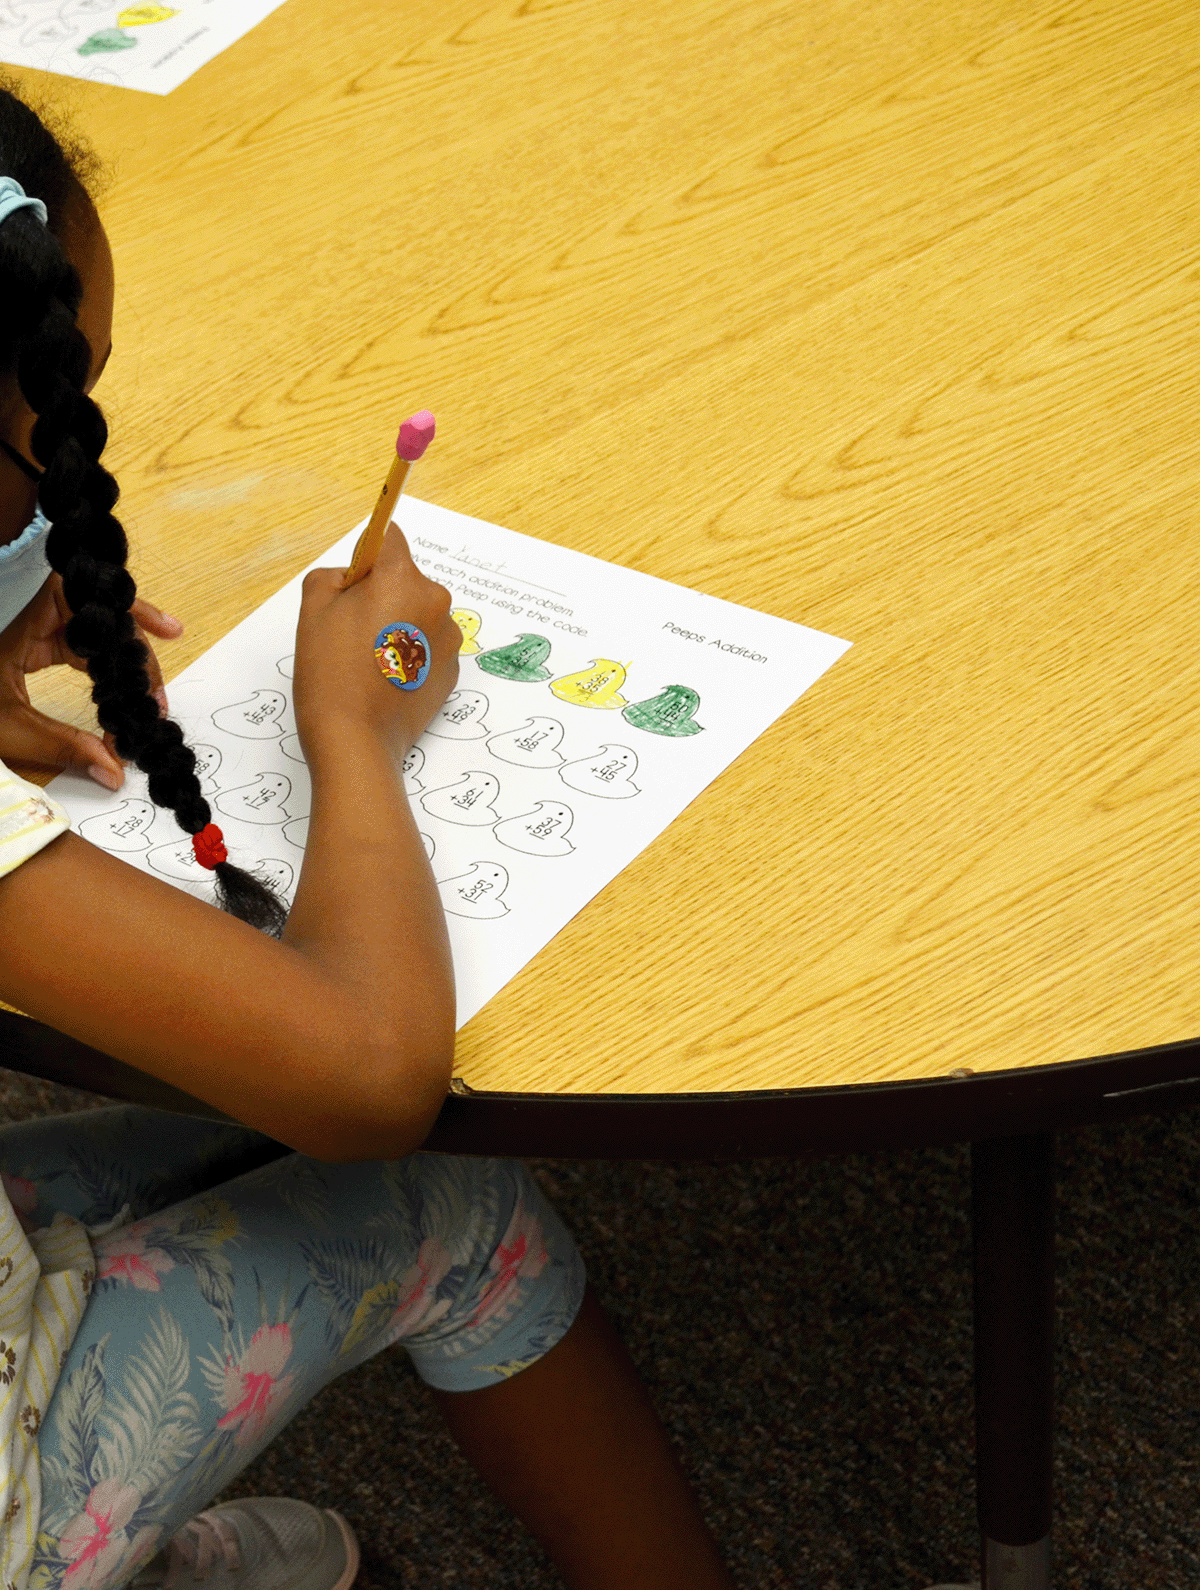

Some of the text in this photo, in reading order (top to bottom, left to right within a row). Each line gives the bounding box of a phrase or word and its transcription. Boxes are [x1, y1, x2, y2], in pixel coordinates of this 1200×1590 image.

[413, 536, 449, 554] Name
[411, 553, 431, 567] lve
[434, 563, 466, 579] each
[469, 575, 519, 597] addition
[455, 583, 489, 602] Peep
[491, 597, 524, 615] using
[526, 609, 550, 623] the
[553, 620, 588, 637] code.
[662, 621, 768, 664] Peeps Addition
[259, 703, 276, 716] 43
[459, 703, 476, 716] 23
[443, 710, 468, 723] +49
[530, 730, 549, 742] 17
[514, 737, 539, 750] +58
[606, 760, 627, 772] 27
[590, 766, 617, 780] +45
[259, 787, 277, 800] 42
[466, 788, 483, 799] 61
[450, 795, 476, 808] +34
[125, 816, 143, 828] 28
[541, 817, 562, 829] 37
[525, 824, 552, 837] +59
[474, 879, 494, 893] 52
[458, 887, 483, 900] +31
